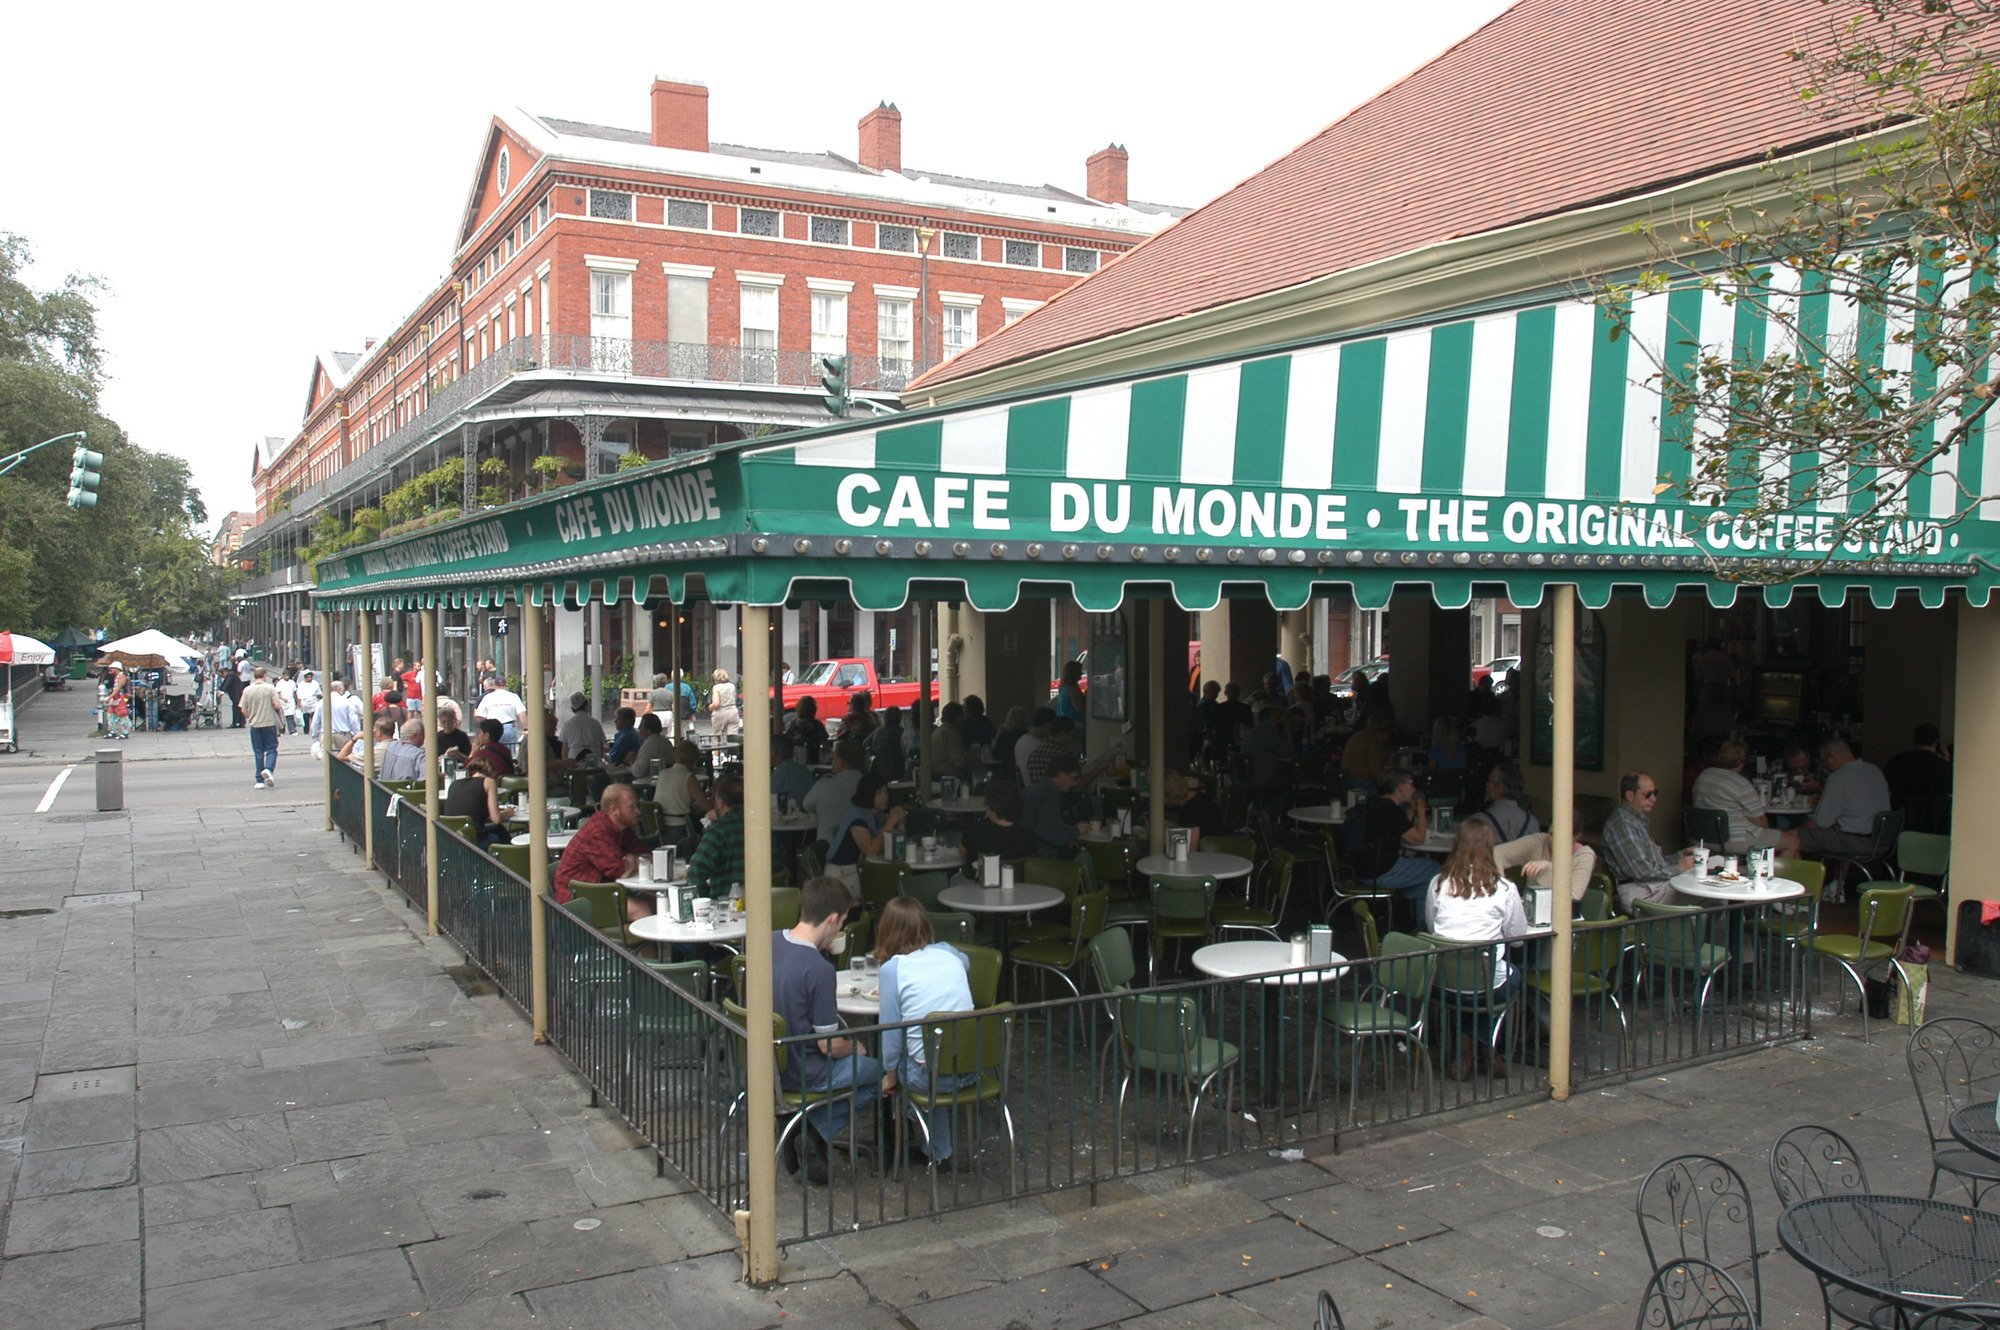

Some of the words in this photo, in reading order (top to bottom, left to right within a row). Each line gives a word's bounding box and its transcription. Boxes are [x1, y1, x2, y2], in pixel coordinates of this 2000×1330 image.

[555, 500, 602, 544] CAFE
[603, 491, 635, 535] DU
[634, 469, 720, 529] MONDE
[836, 474, 1010, 531] CAFE
[1050, 482, 1131, 534] DU
[1152, 486, 1348, 540] MONDE
[1398, 498, 1489, 543] THE
[1502, 501, 1695, 548] ORIGINAL
[1705, 510, 1835, 552] COFFEE
[408, 536, 442, 566] MARKET
[438, 529, 473, 563] COFFEE
[469, 519, 509, 556] STAND
[21, 653, 46, 663] Enjoy
